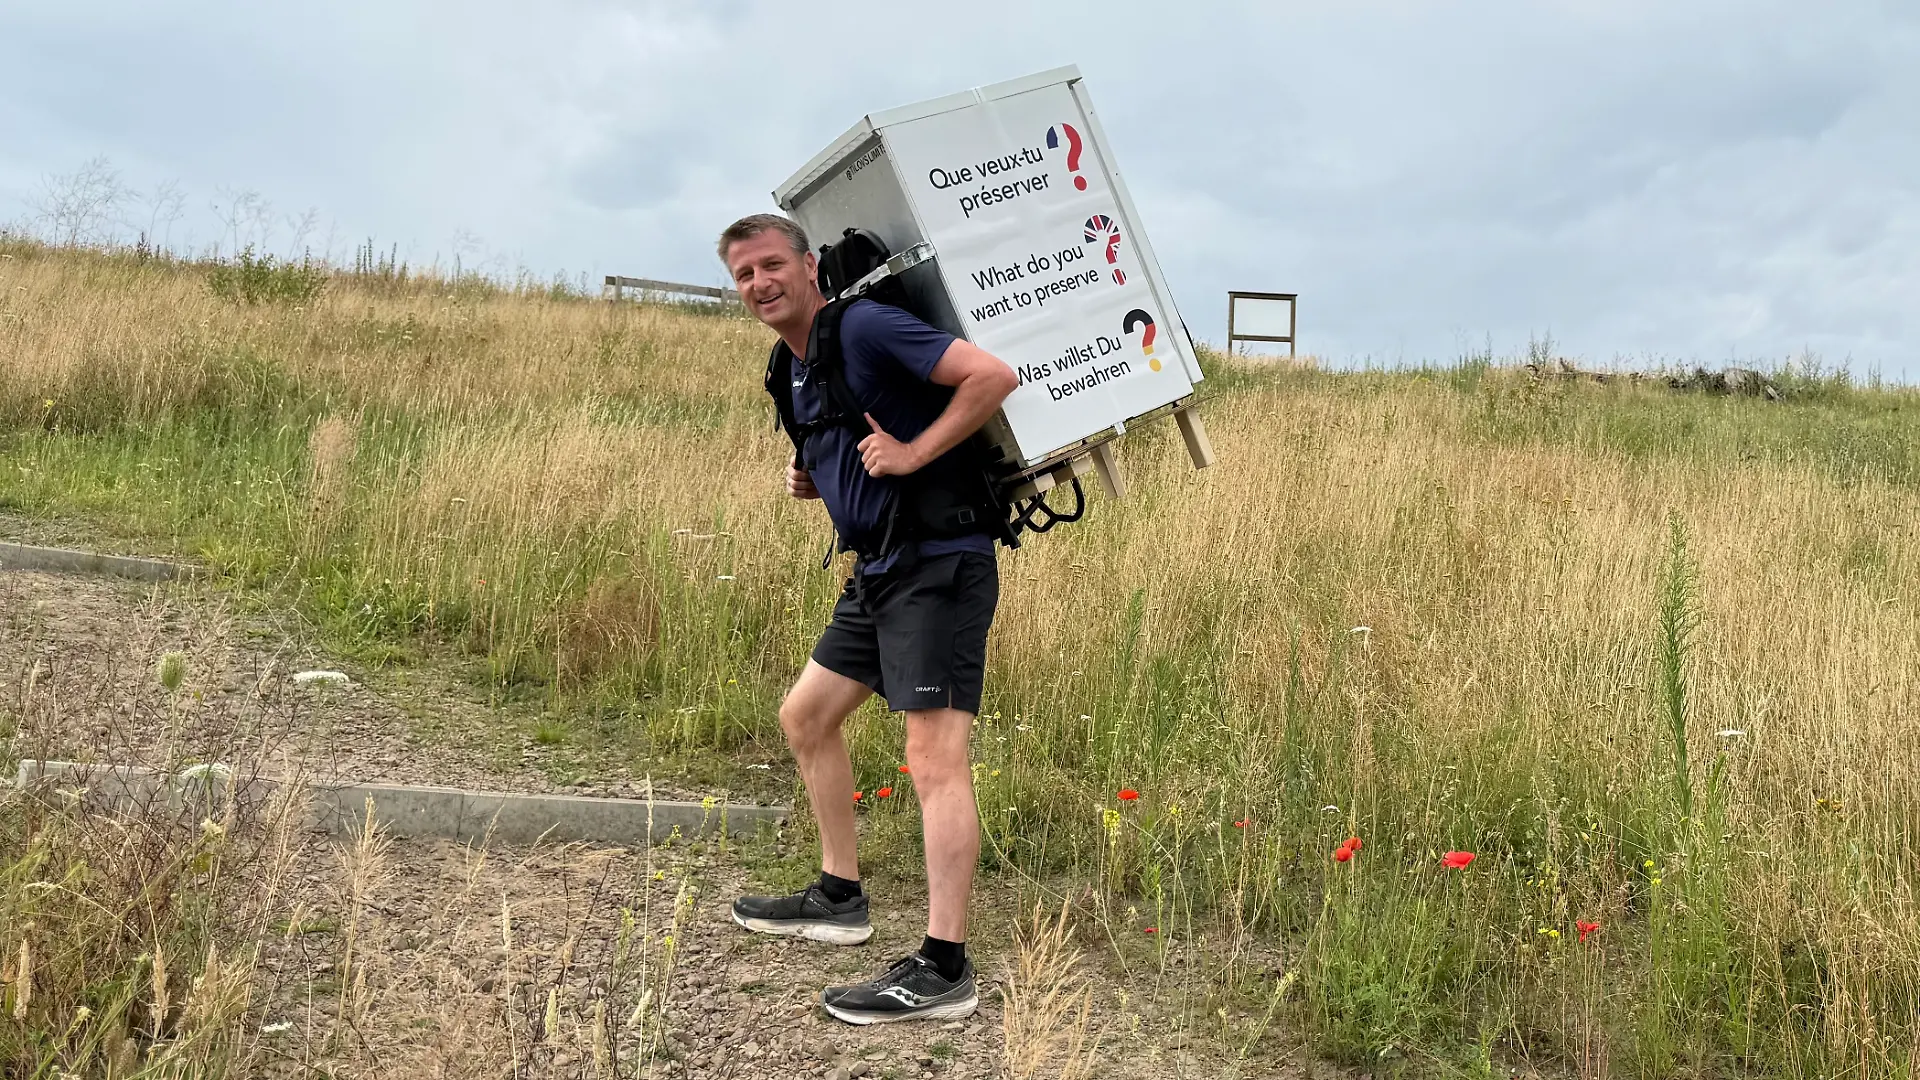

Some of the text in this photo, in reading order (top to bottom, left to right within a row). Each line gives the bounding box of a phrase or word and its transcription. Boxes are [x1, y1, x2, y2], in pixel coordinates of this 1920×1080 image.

[929, 147, 1044, 190] Que veux-tu
[959, 173, 1049, 218] préserver
[971, 245, 1084, 291] What do you
[971, 269, 1099, 322] want to preserve
[1053, 343, 1097, 372] willst
[1096, 336, 1122, 356] Du
[1046, 360, 1131, 402] bewahren
